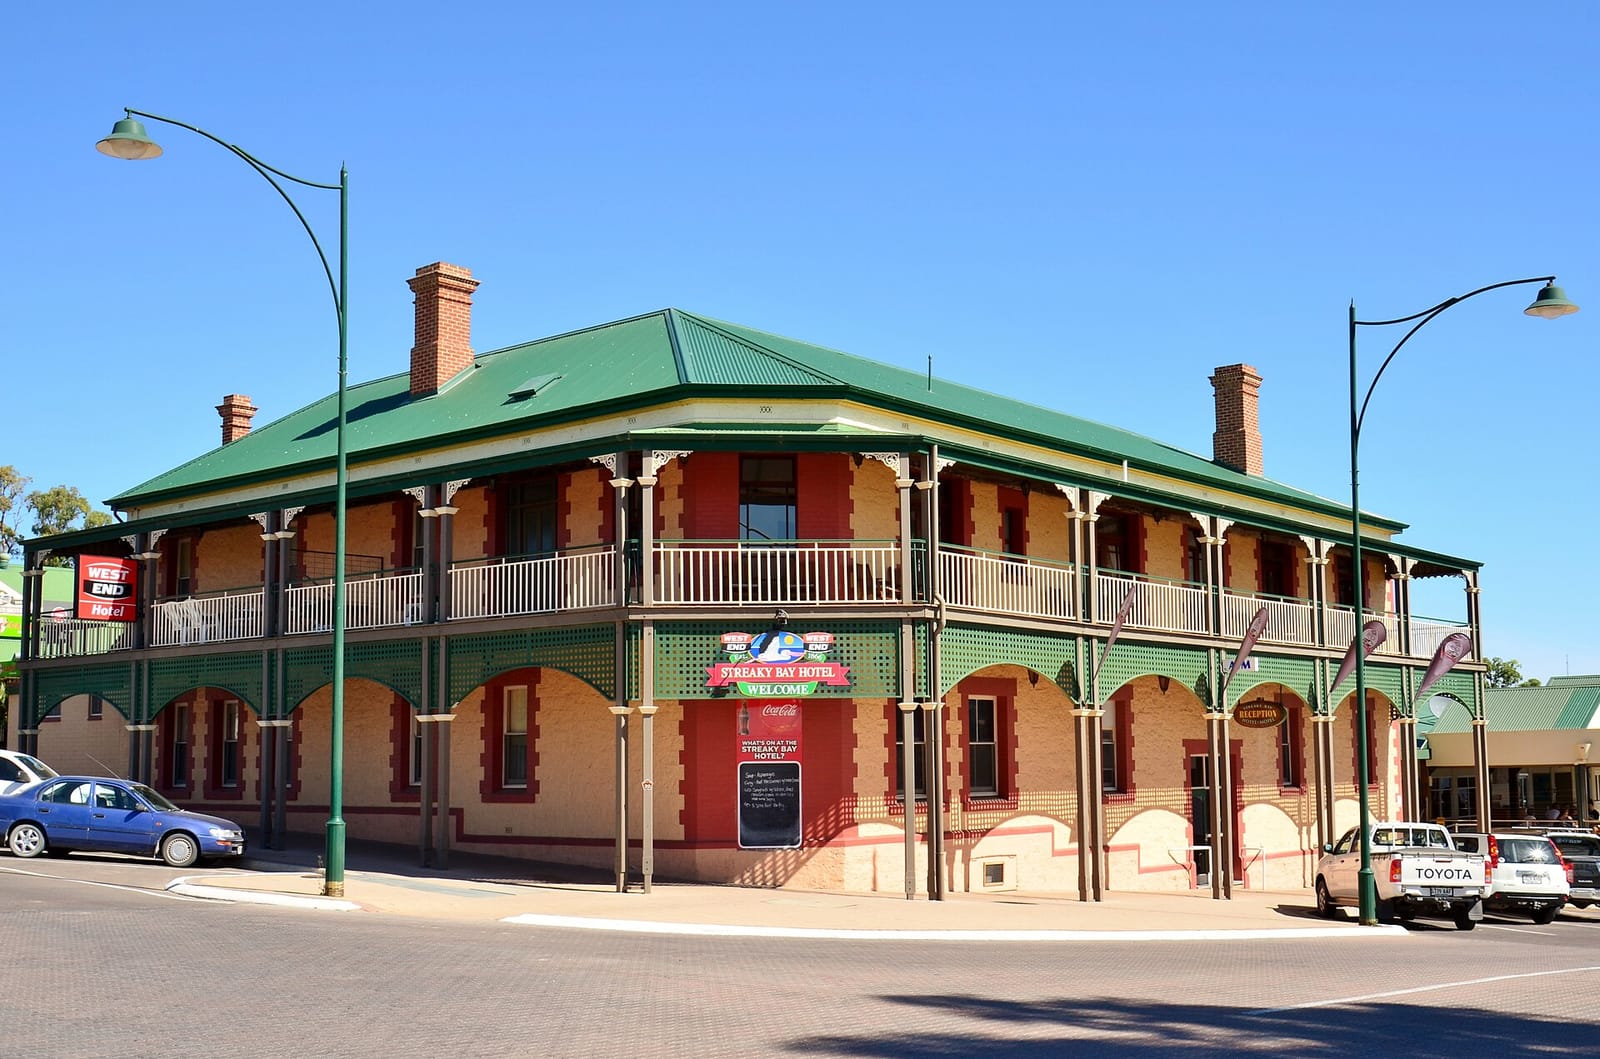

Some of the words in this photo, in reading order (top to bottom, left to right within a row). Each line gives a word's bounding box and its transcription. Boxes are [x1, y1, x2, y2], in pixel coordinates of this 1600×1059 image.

[88, 566, 129, 580] WEST
[92, 582, 124, 595] END
[91, 604, 124, 617] Hotel
[1228, 660, 1251, 669] AM
[720, 666, 773, 679] STREAKY
[775, 666, 798, 678] BAY
[798, 666, 836, 678] HOTEL
[747, 684, 809, 695] WELCOME
[1239, 709, 1277, 718] RECEPTION
[1415, 868, 1472, 879] TOYOTA
